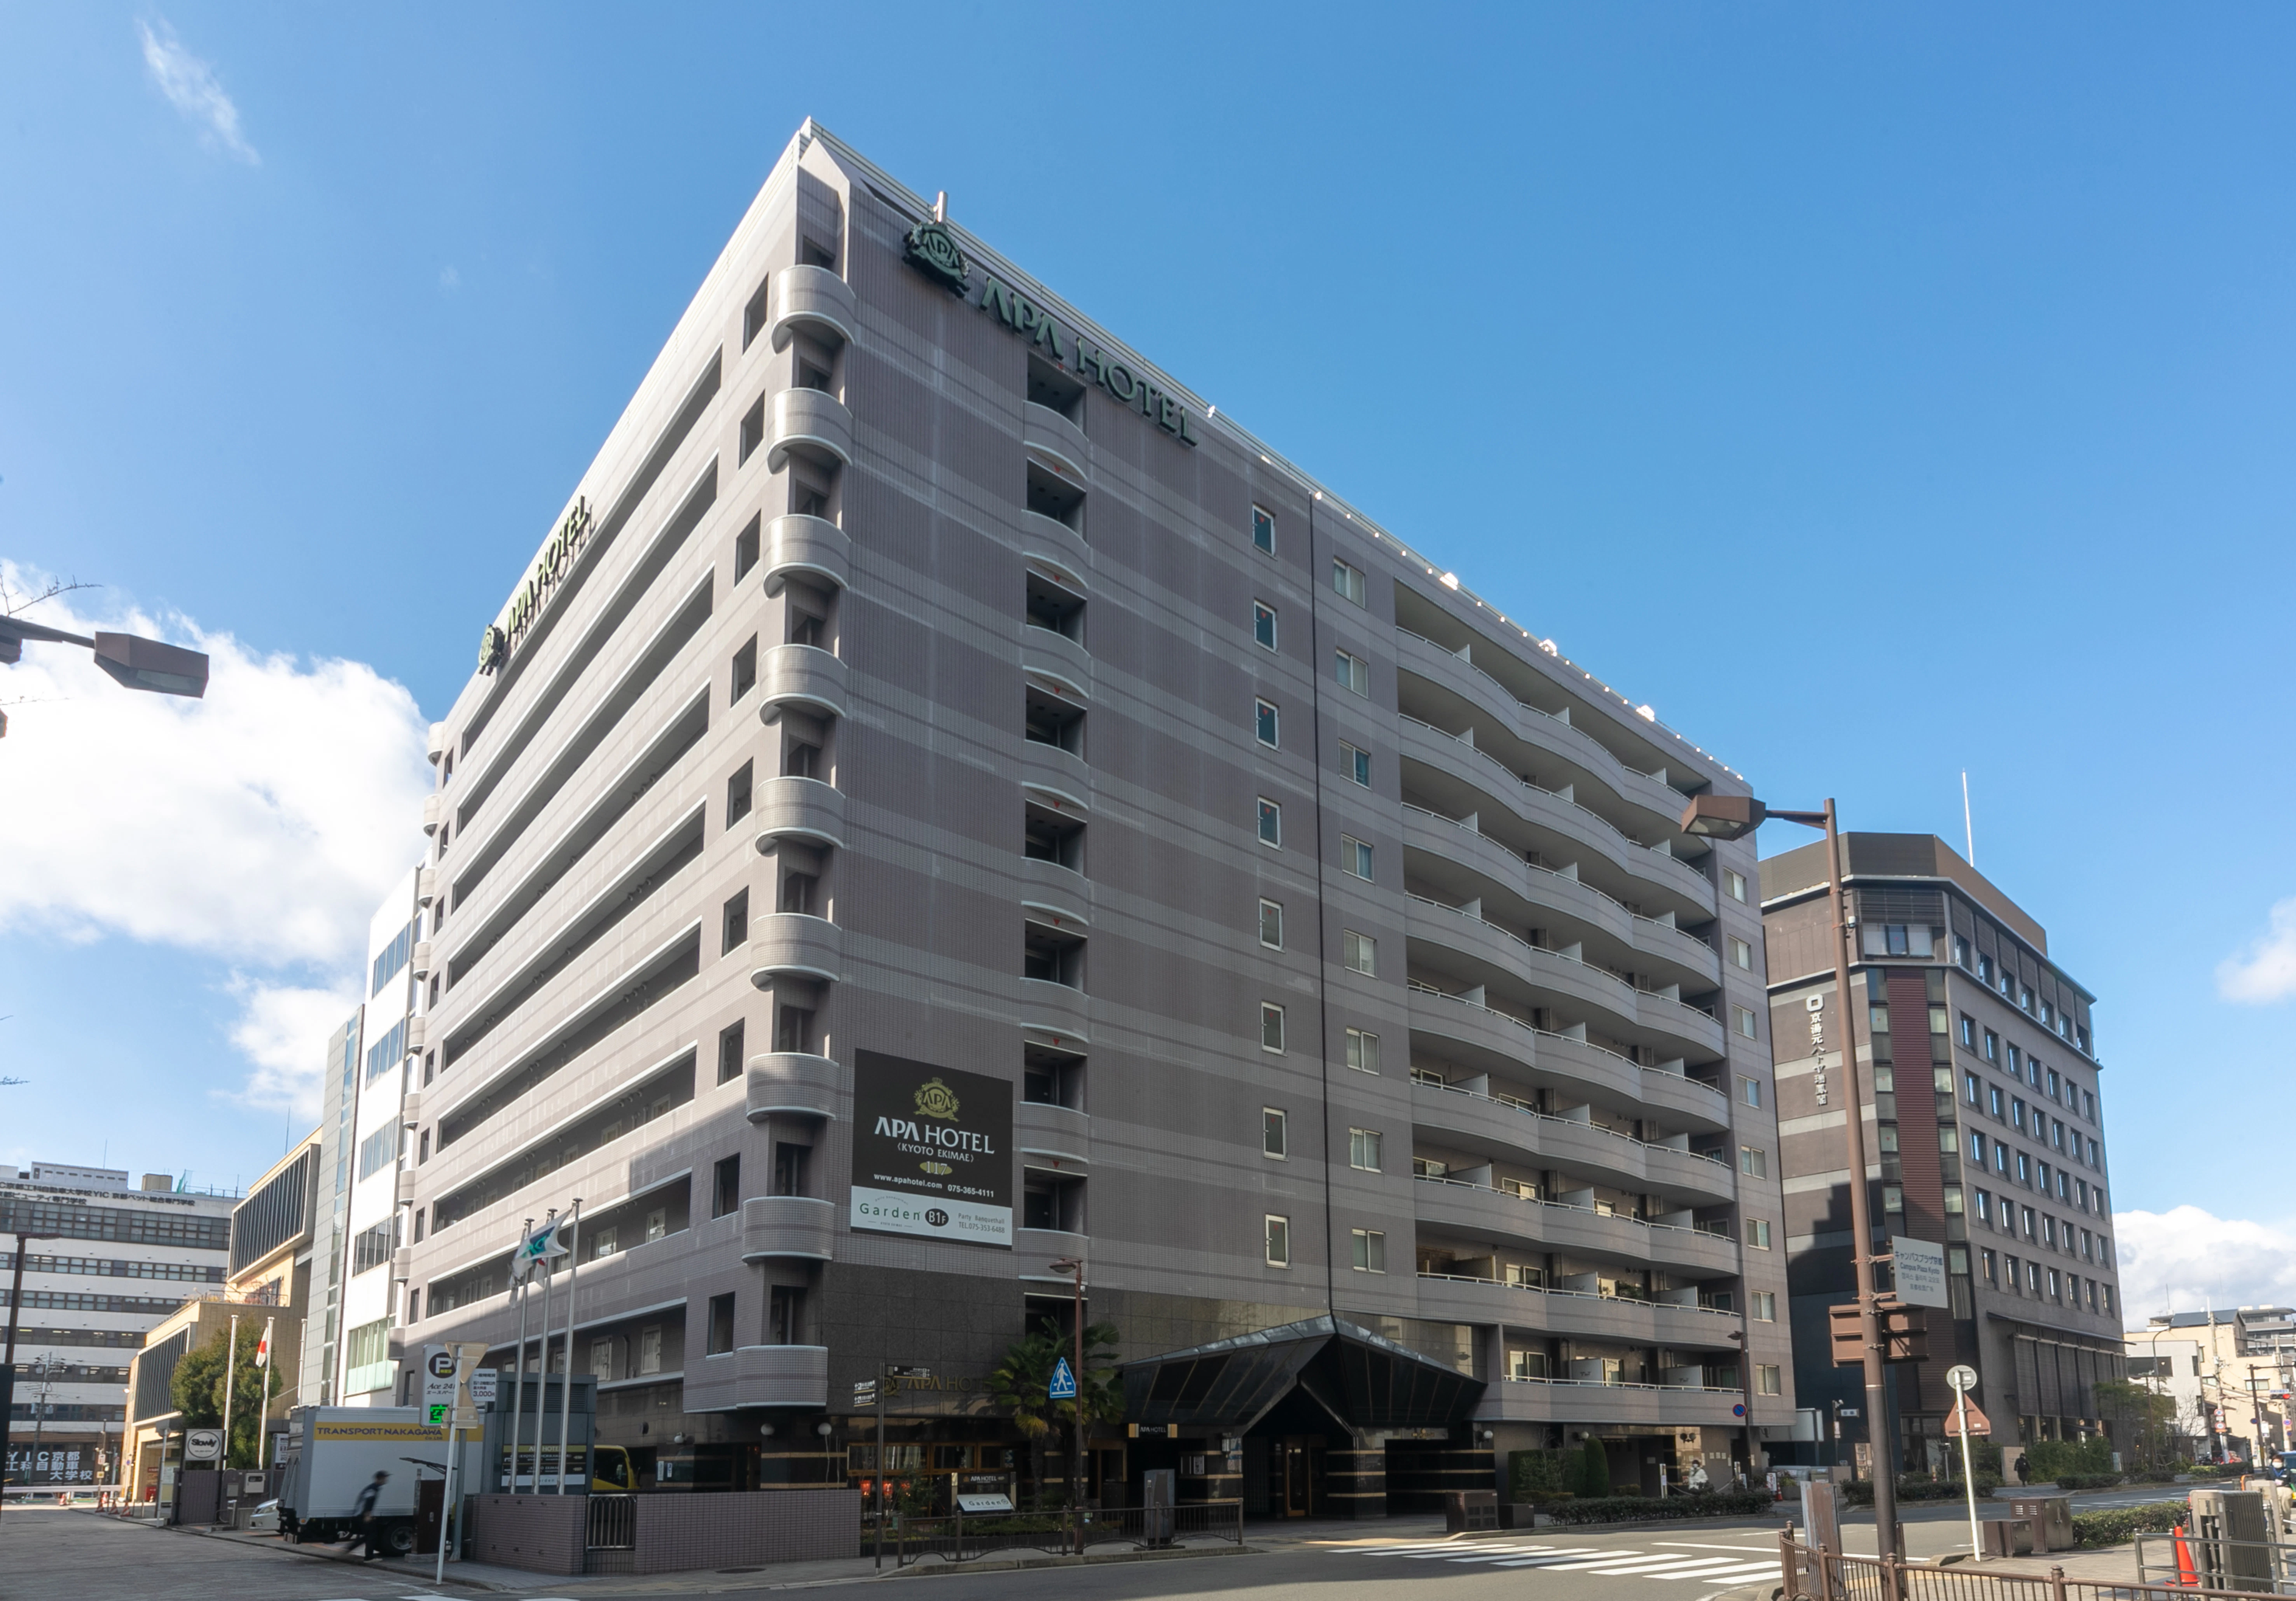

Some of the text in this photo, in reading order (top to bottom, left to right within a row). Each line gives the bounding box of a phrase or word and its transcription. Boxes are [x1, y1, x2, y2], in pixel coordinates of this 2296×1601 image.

[980, 276, 1198, 447] APA HOTEL
[874, 1116, 995, 1155] APA HOTEL
[926, 1161, 948, 1176] 117
[874, 1173, 994, 1197] www.apahotel.com 075-365-4111
[860, 1203, 921, 1221] Garden
[958, 1213, 1005, 1225] Party Banquethall
[1895, 1250, 1943, 1265] キャンパスプラザ京都
[1900, 1262, 1917, 1271] Campus
[1928, 1267, 1940, 1275] Kyoto
[435, 1357, 453, 1374] P
[907, 1375, 942, 1390] APA
[49, 1470, 93, 1480] 大学校
